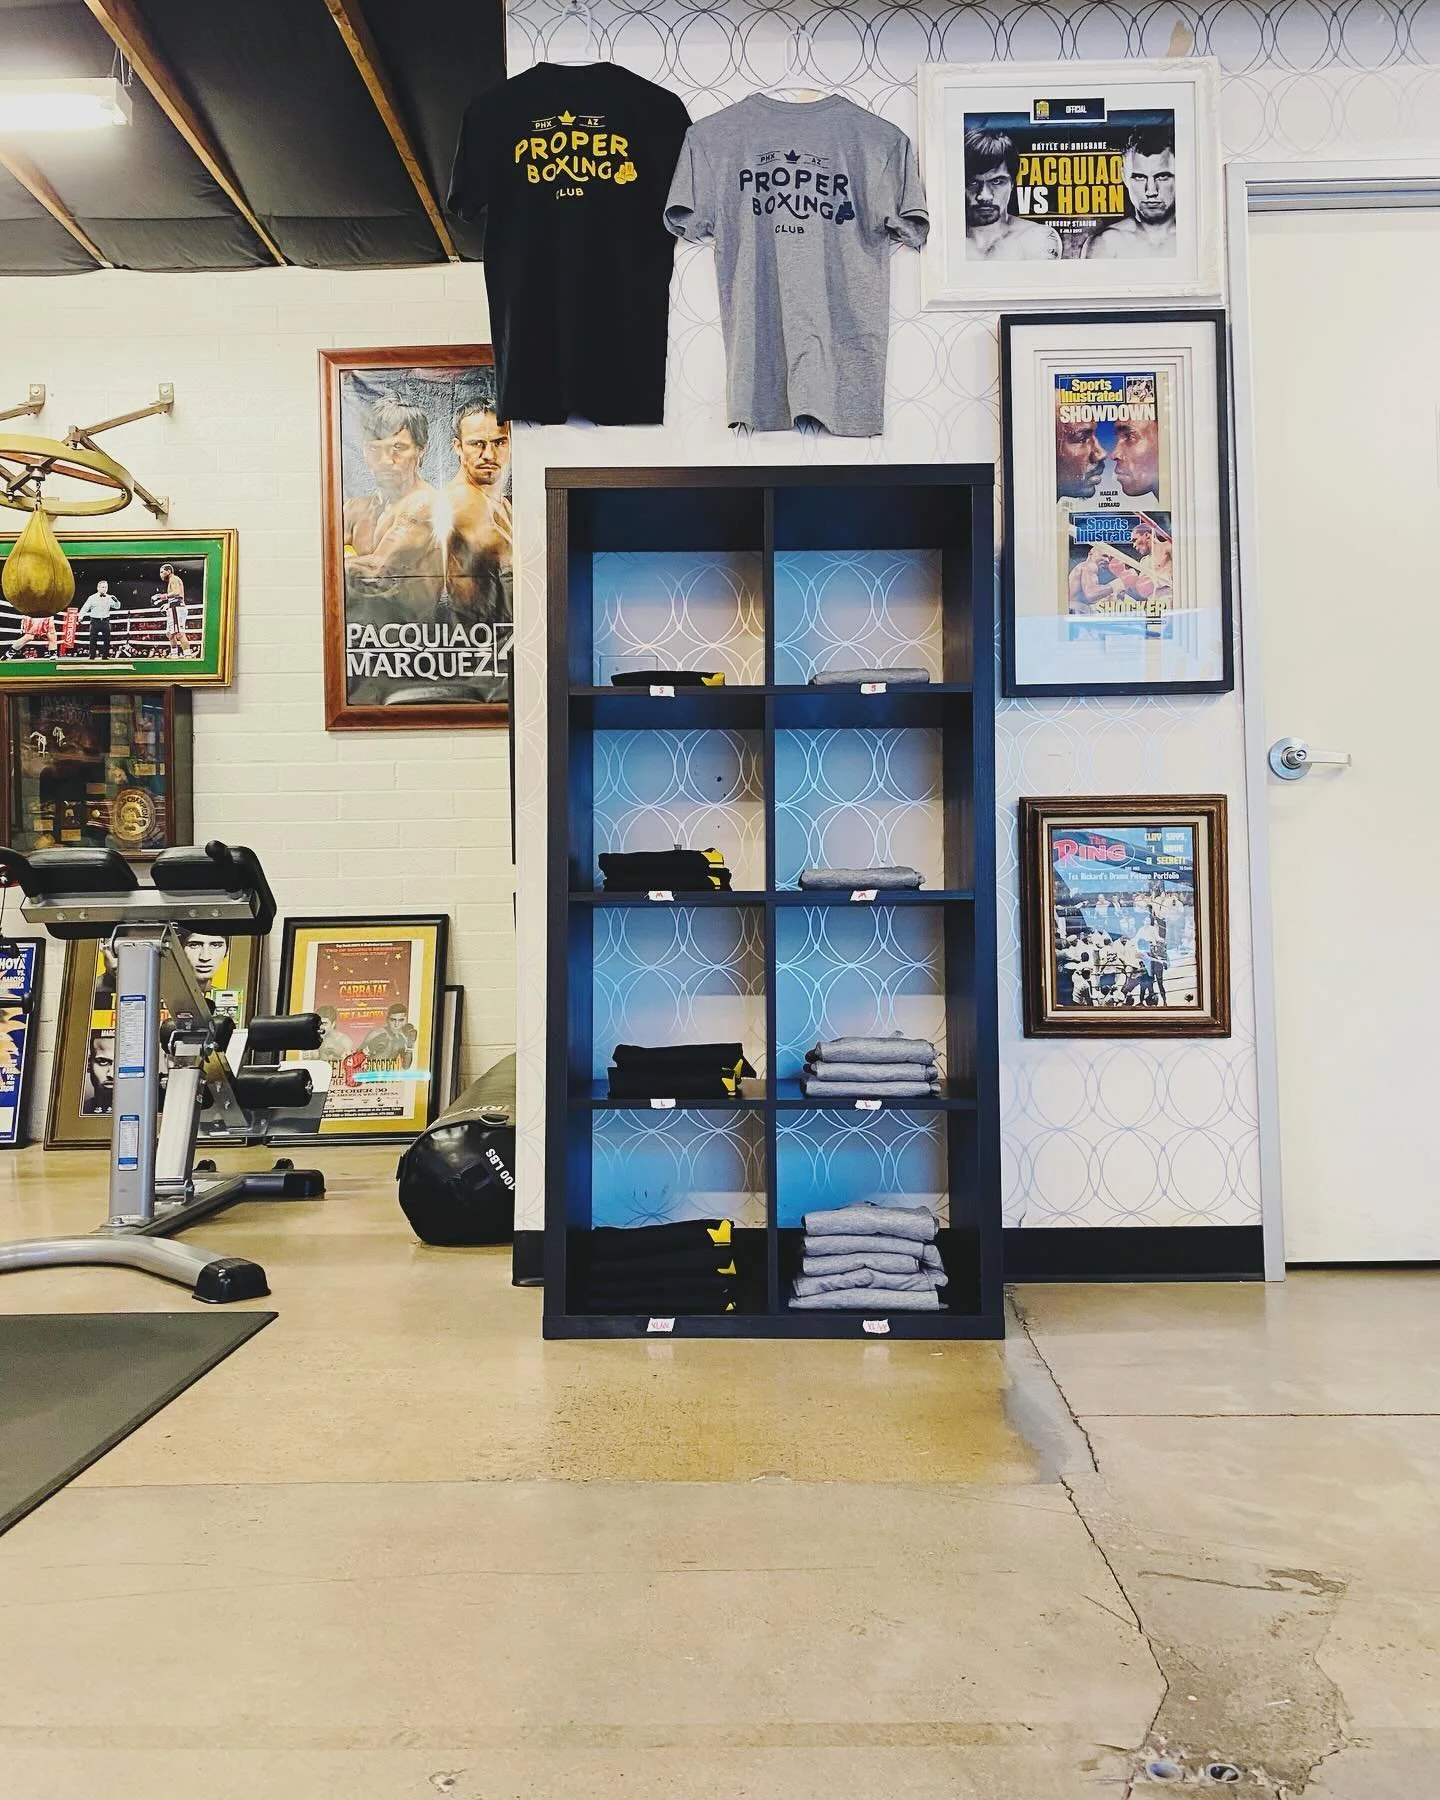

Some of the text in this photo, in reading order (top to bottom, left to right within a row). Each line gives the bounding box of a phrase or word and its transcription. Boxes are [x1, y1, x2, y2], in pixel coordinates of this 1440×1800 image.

[535, 118, 599, 129] PHX AZ
[515, 130, 629, 164] PROPER
[527, 155, 612, 184] BOXING
[760, 152, 822, 166] PHX AZ
[1016, 155, 1124, 186] PACQUIAO
[739, 167, 849, 197] PROPER
[752, 192, 834, 220] BOXING
[1016, 184, 1125, 215] VS HORN
[775, 224, 805, 234] CLUB
[1060, 389, 1123, 403] Illustrated
[1071, 378, 1112, 392] Sports
[1060, 403, 1156, 423] SHOWDOWN
[1075, 527, 1132, 542] Illustrate
[1087, 517, 1129, 531] Sports
[346, 622, 494, 652] PACQUIAO
[346, 651, 495, 680] MARQUEZ
[1053, 839, 1127, 865] RING
[1153, 871, 1180, 880] Portfolio
[485, 1148, 505, 1171] LBS
